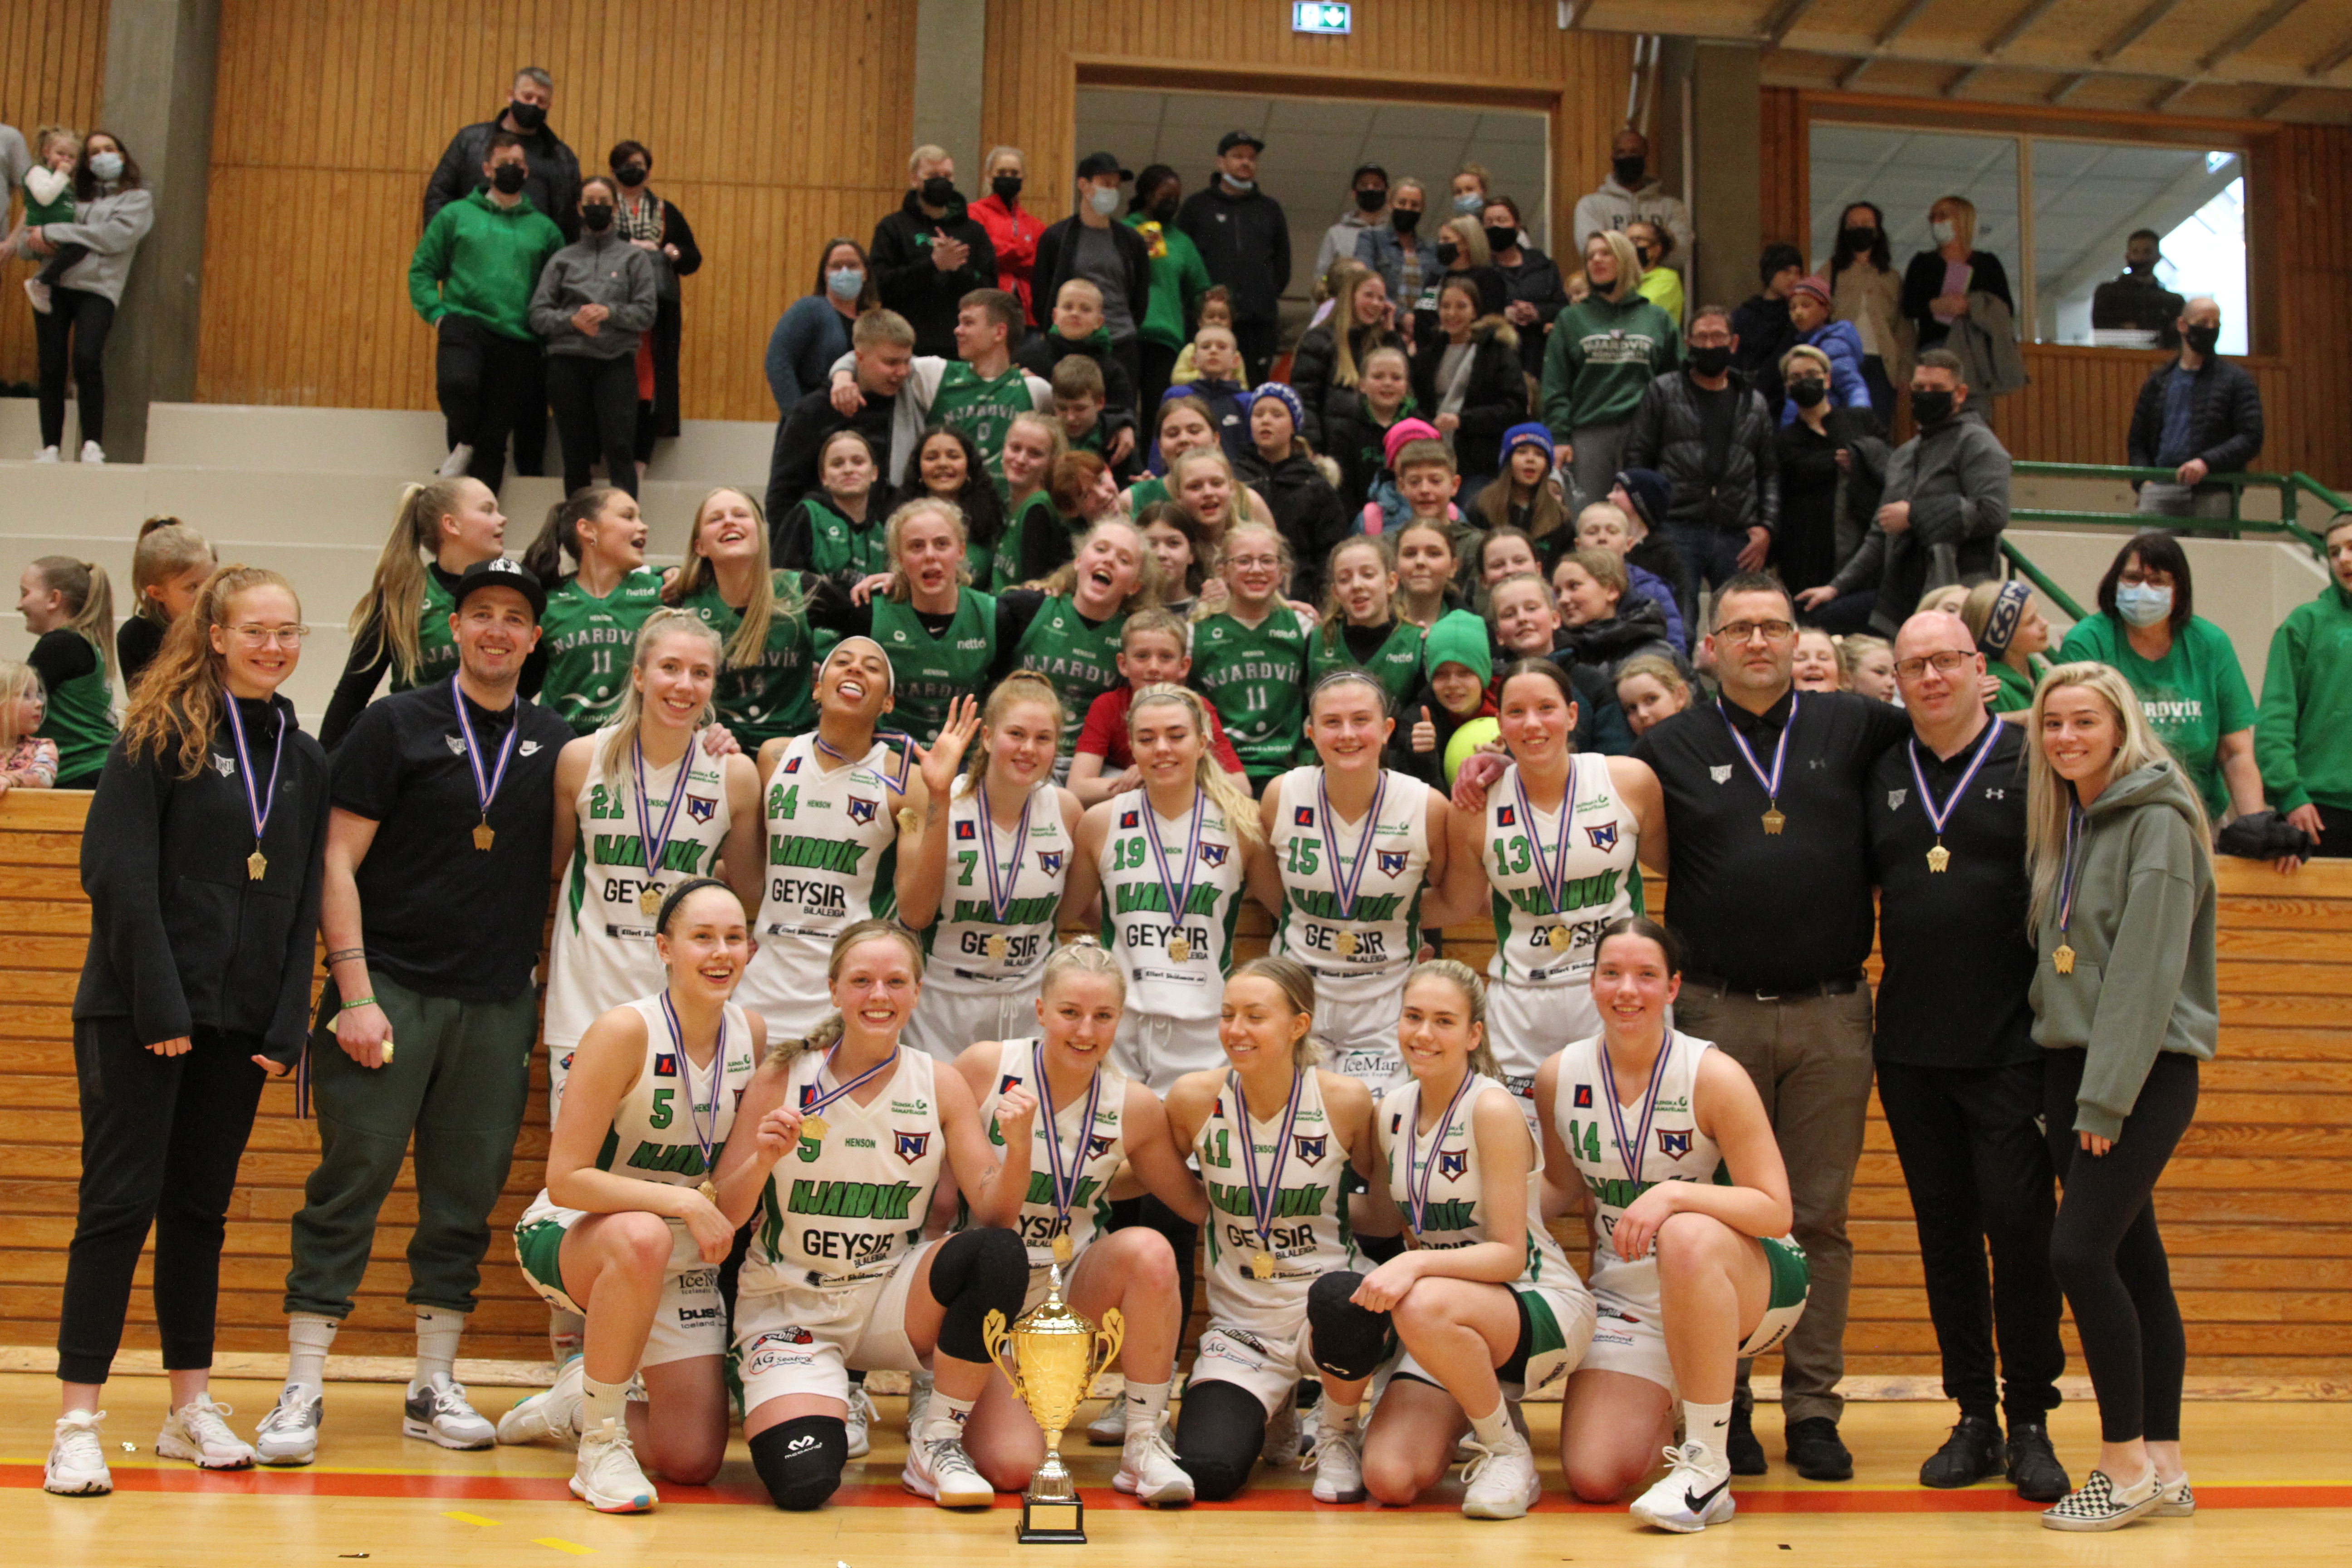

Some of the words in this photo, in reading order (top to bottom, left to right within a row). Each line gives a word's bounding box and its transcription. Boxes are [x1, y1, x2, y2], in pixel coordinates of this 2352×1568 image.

[593, 651, 612, 674] 11
[1246, 686, 1267, 711] 11
[590, 784, 624, 818] 21
[769, 784, 799, 819] 24
[807, 799, 831, 809] HENSON
[1113, 836, 1146, 871] 19
[1287, 837, 1321, 875] 15
[1494, 835, 1531, 876] 13
[958, 850, 978, 886] 7
[773, 878, 846, 908] GEYSIR
[1343, 1057, 1398, 1073] IceMar
[650, 1089, 674, 1129] 5
[694, 1103, 720, 1112] HENSN
[845, 1138, 876, 1148] HENSON
[902, 1137, 922, 1154] N
[1301, 1141, 1322, 1156] N
[1569, 1120, 1601, 1162] 14
[1665, 1135, 1686, 1151] N
[1444, 1156, 1460, 1171] N
[803, 1230, 894, 1259] GEYSIR
[681, 1321, 715, 1329] Iceland
[1205, 1343, 1225, 1352] AG
[752, 1352, 774, 1370] AG
